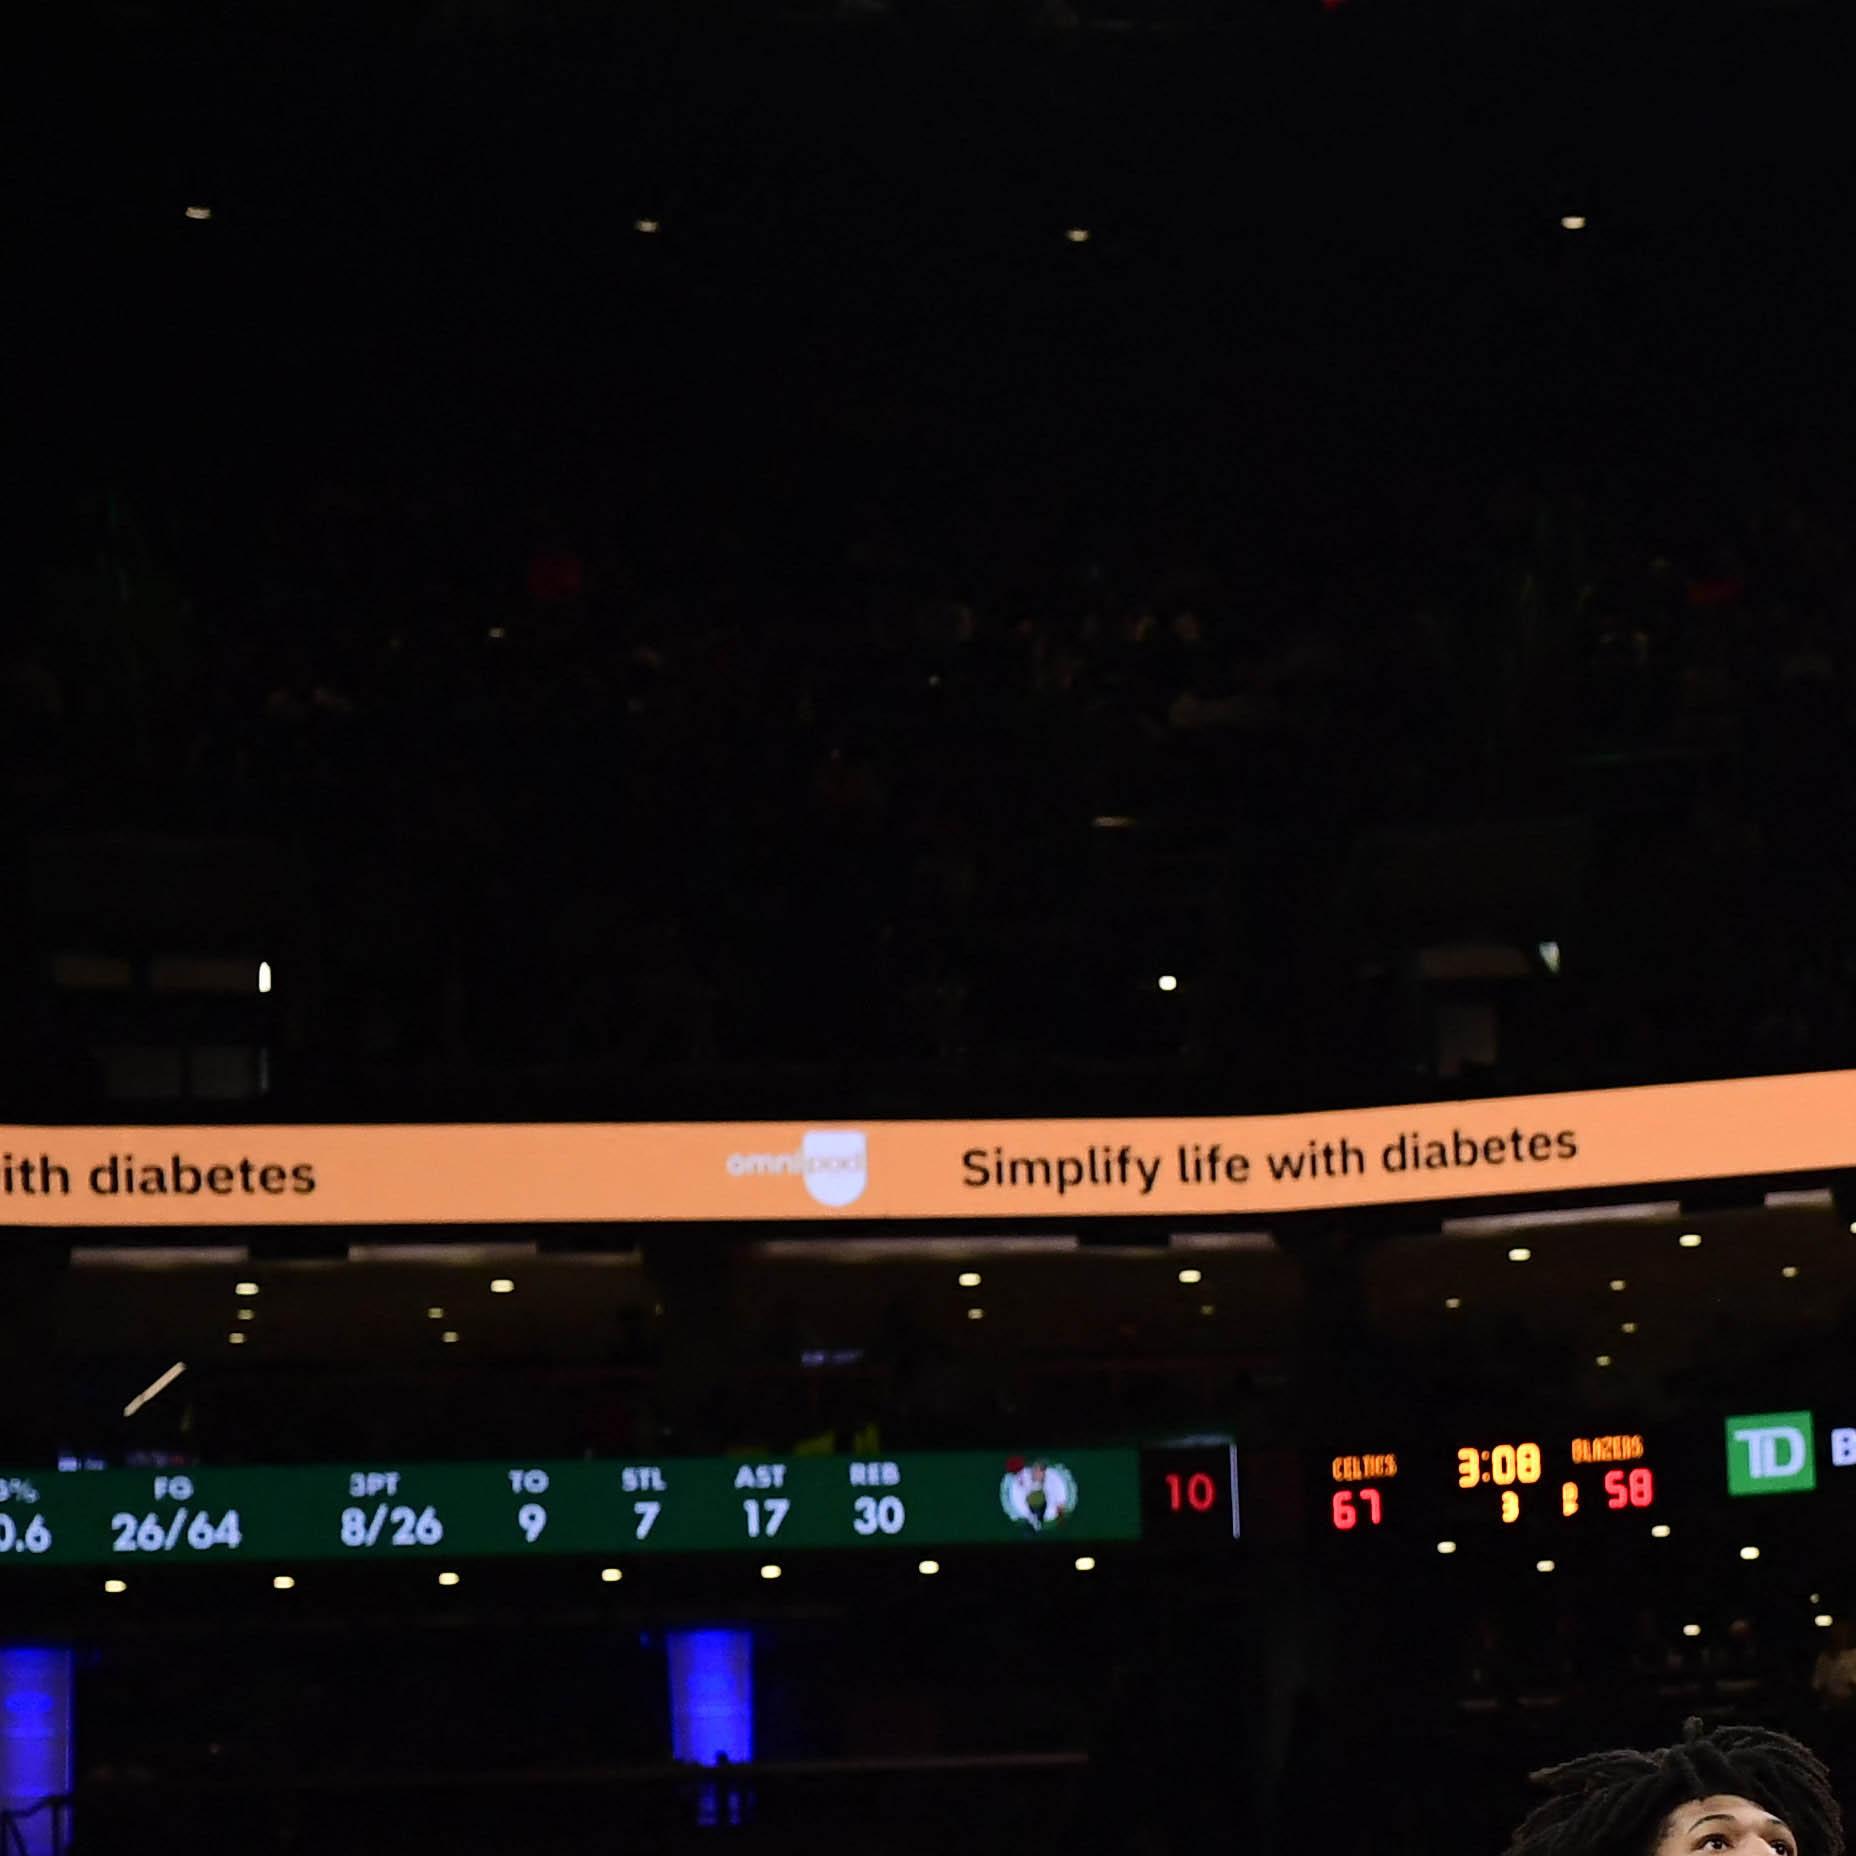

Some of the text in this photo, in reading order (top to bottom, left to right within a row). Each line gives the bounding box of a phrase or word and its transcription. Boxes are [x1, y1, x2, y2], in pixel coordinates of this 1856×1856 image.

[3, 1152, 316, 1196] ith diabetes
[963, 1128, 1577, 1195] Simplify life with diabetes
[1332, 1454, 1398, 1482] CELTICS
[1458, 1442, 1541, 1488] 3:08
[1571, 1435, 1644, 1464] BLAZERS
[1733, 1426, 1806, 1478] TD
[509, 1470, 549, 1493] TO
[622, 1468, 667, 1491] STL
[735, 1465, 786, 1488] AST
[1166, 1473, 1215, 1512] 10
[1604, 1467, 1653, 1510] 58
[111, 1507, 242, 1551] 26/64
[341, 1503, 443, 1546] 8/26
[518, 1504, 547, 1542] 9
[633, 1501, 661, 1540] 7
[742, 1498, 790, 1538] 17
[853, 1496, 905, 1535] 30
[1332, 1488, 1381, 1530] 67
